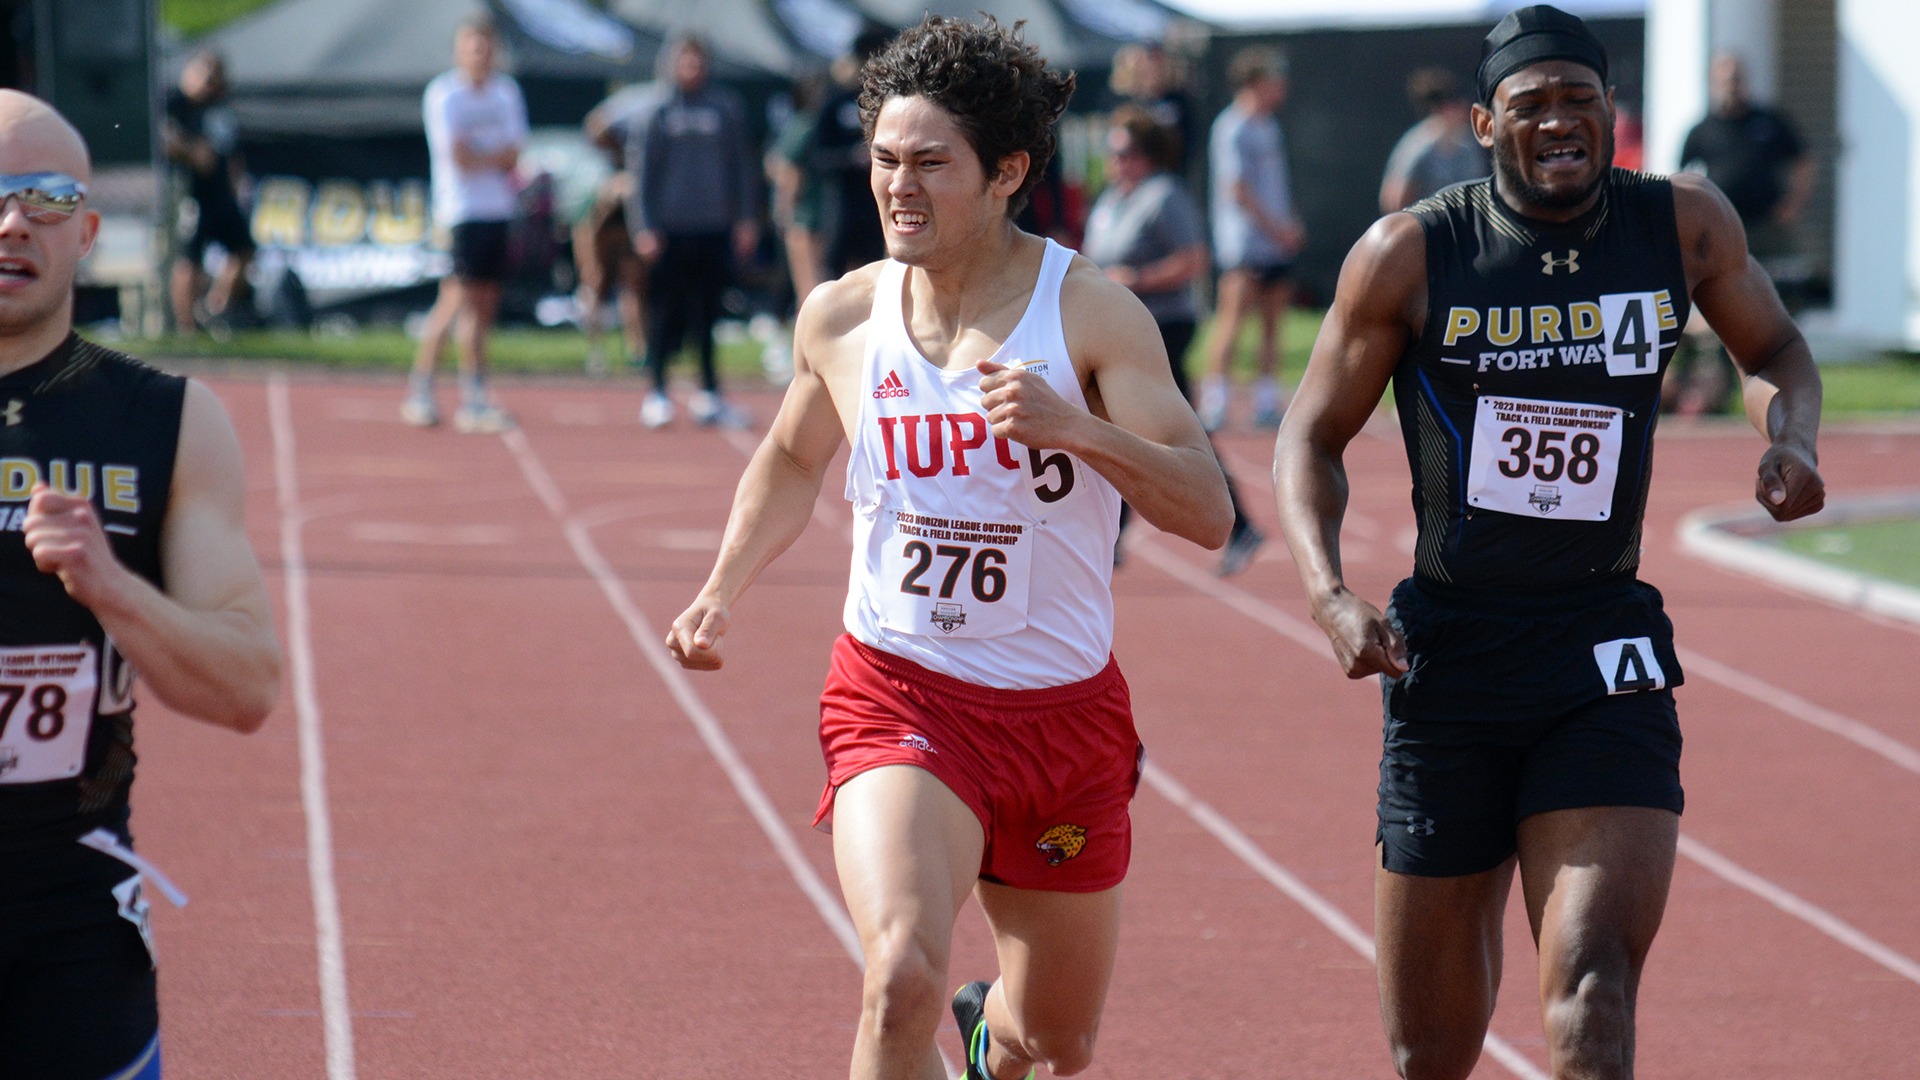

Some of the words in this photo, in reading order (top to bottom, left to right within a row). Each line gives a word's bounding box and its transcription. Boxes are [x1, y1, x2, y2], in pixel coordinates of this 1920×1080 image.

[1443, 289, 1678, 346] PURDE
[1612, 299, 1652, 369] 4
[1477, 348, 1554, 373] FORT
[872, 386, 910, 399] adidas
[1493, 401, 1514, 411] 2023
[1516, 403, 1550, 415] HORIZON
[1551, 406, 1579, 417] LEAGUE
[1580, 409, 1615, 420] OUTDOOR
[878, 412, 1021, 481] IUP
[1496, 412, 1522, 423] TRACK
[1523, 415, 1530, 424] &
[1531, 415, 1551, 426] FIELD
[1553, 418, 1610, 430] CHAMPIONSHIP
[1027, 447, 1075, 504] 5
[1498, 427, 1600, 485] 358
[897, 511, 914, 524] 2023
[915, 515, 949, 529] HORIZON
[950, 519, 981, 532] LEAGUE
[982, 523, 1023, 535] OUTDOOR
[899, 523, 921, 536] TRACK
[922, 529, 929, 537] &
[930, 529, 951, 540] FIELD
[953, 531, 1018, 545] CHAMPIONSHIP
[900, 540, 1007, 603] 276
[1613, 643, 1656, 692] 4
[0, 684, 67, 741] 78
